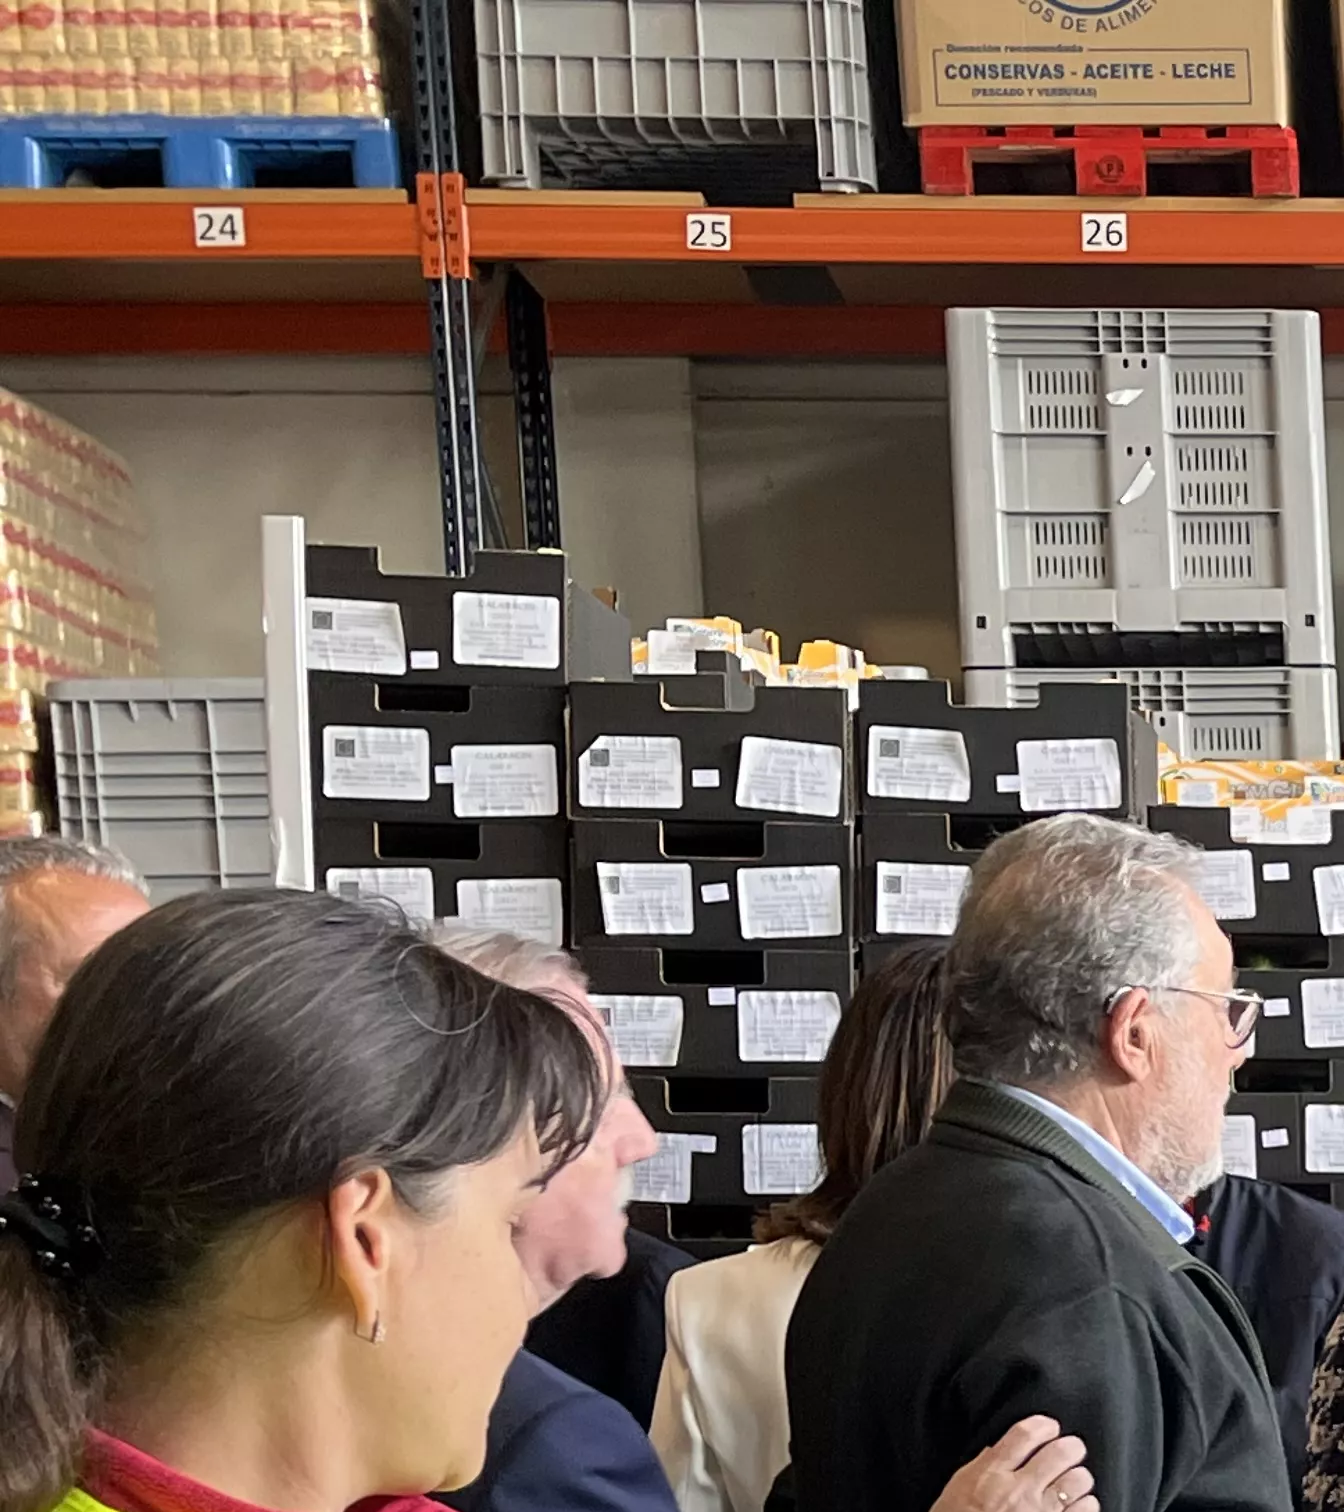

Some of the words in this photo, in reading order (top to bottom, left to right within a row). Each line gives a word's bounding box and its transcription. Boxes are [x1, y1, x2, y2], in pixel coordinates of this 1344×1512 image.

[1060, 15, 1087, 33] DE
[1095, 0, 1158, 33] ALIME
[944, 63, 1065, 80] CONSERVAS
[1083, 63, 1153, 79] ACEITE
[1172, 63, 1236, 79] LECHE
[197, 213, 238, 243] 24
[690, 219, 727, 248] 25
[1085, 219, 1124, 248] 26
